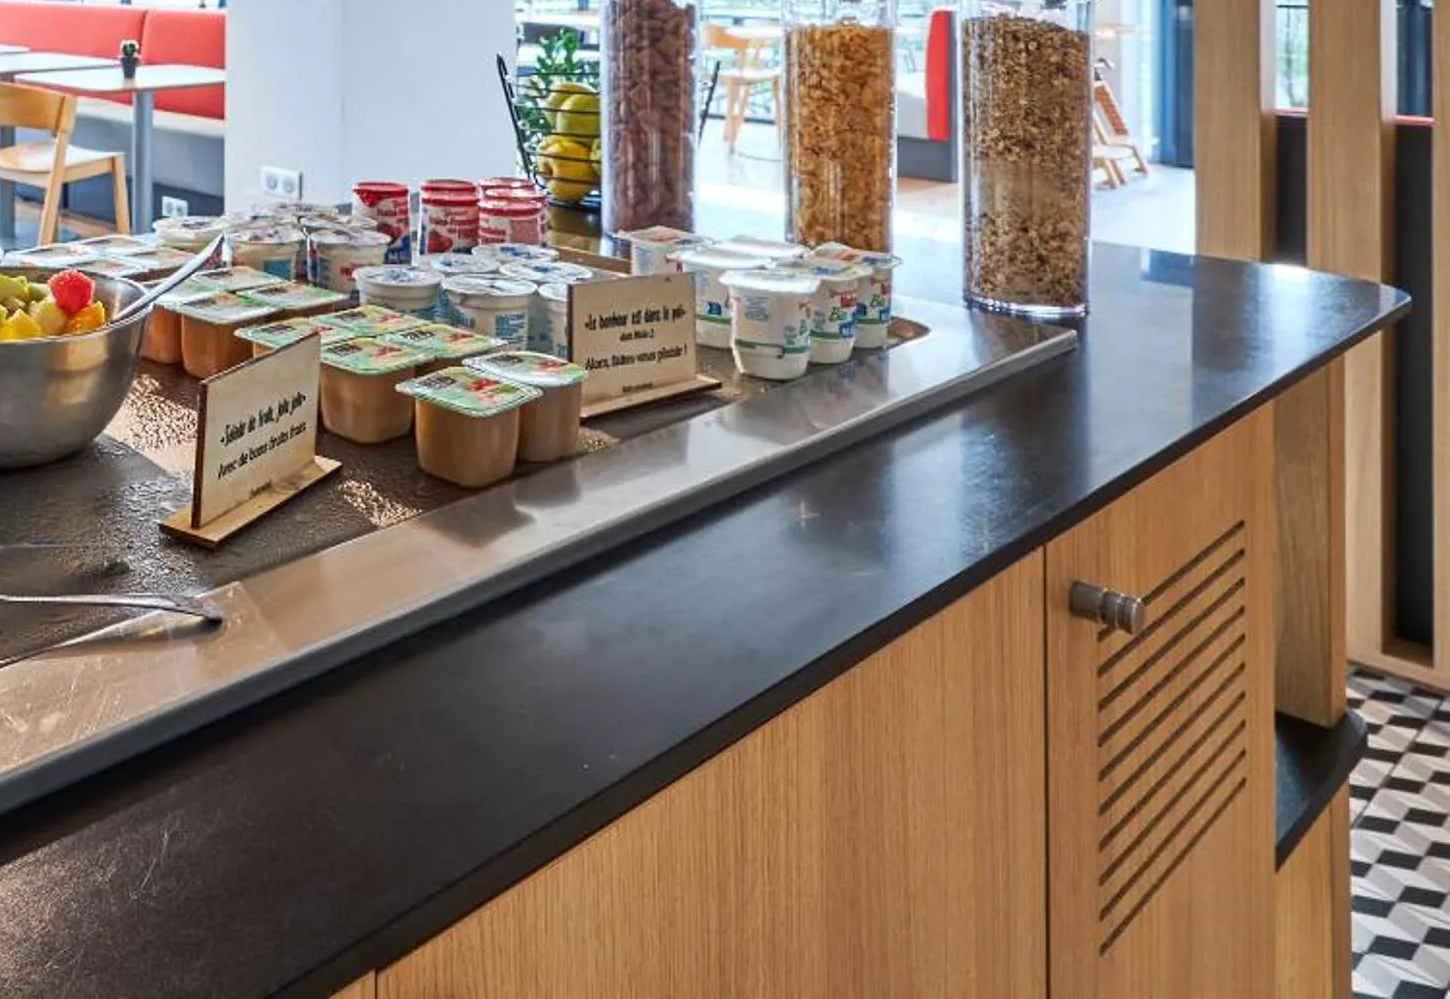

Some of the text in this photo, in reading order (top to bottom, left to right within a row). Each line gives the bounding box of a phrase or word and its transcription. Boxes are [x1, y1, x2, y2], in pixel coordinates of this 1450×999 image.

[217, 421, 306, 480] Avec de bons fruits frais
